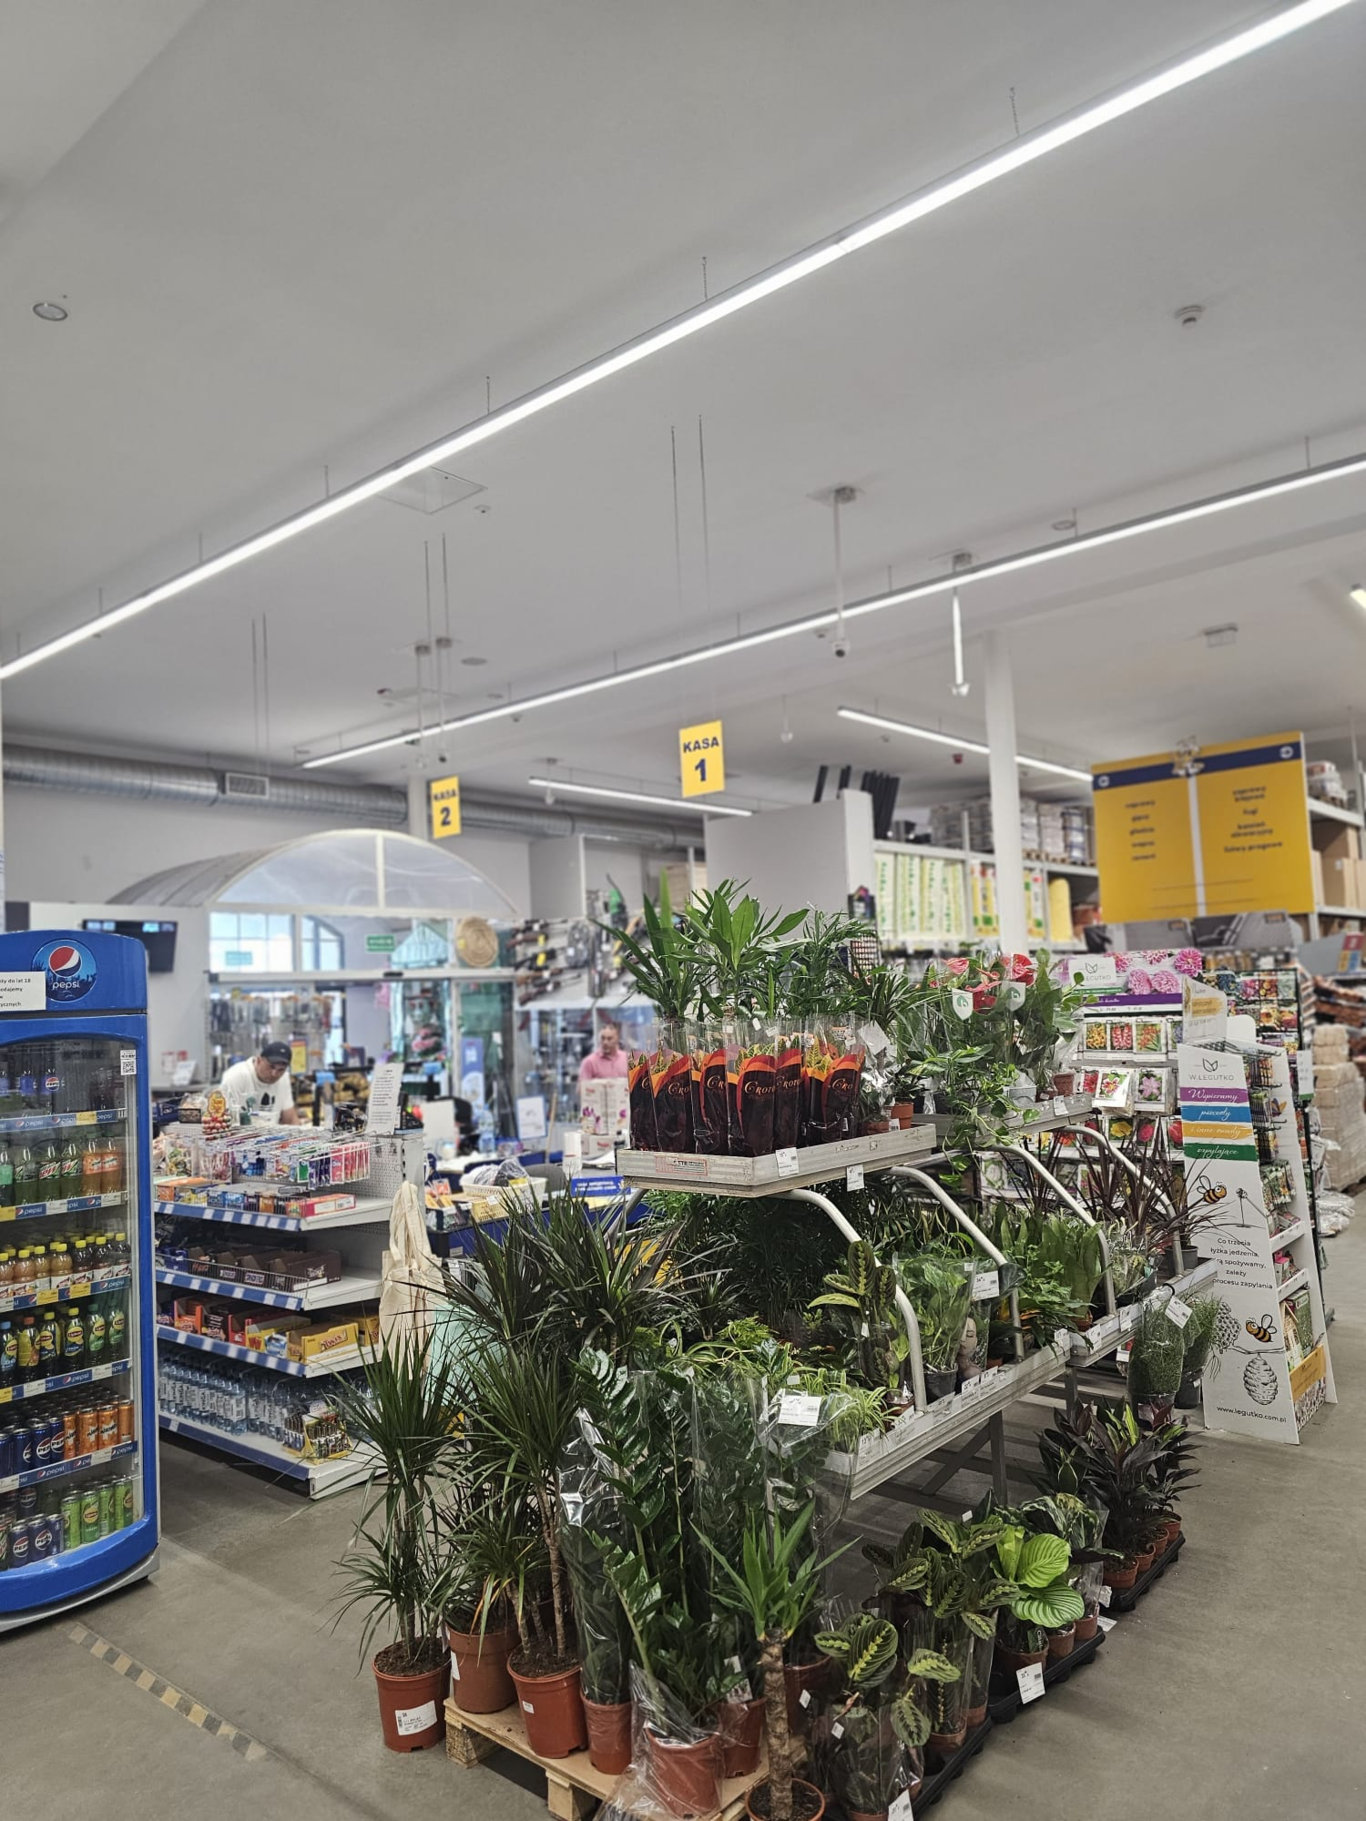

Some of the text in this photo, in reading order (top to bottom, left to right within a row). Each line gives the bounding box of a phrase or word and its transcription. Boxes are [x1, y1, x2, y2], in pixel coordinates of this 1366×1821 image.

[683, 736, 719, 753] KASA
[695, 758, 706, 782] 1
[440, 806, 452, 826] 2
[52, 980, 80, 991] pepsi
[1188, 1088, 1239, 1103] Wspieramy
[1228, 1239, 1251, 1247] trzecia
[1240, 1281, 1273, 1290] zapylania
[1217, 1405, 1287, 1423] www.legutko.com.pl
